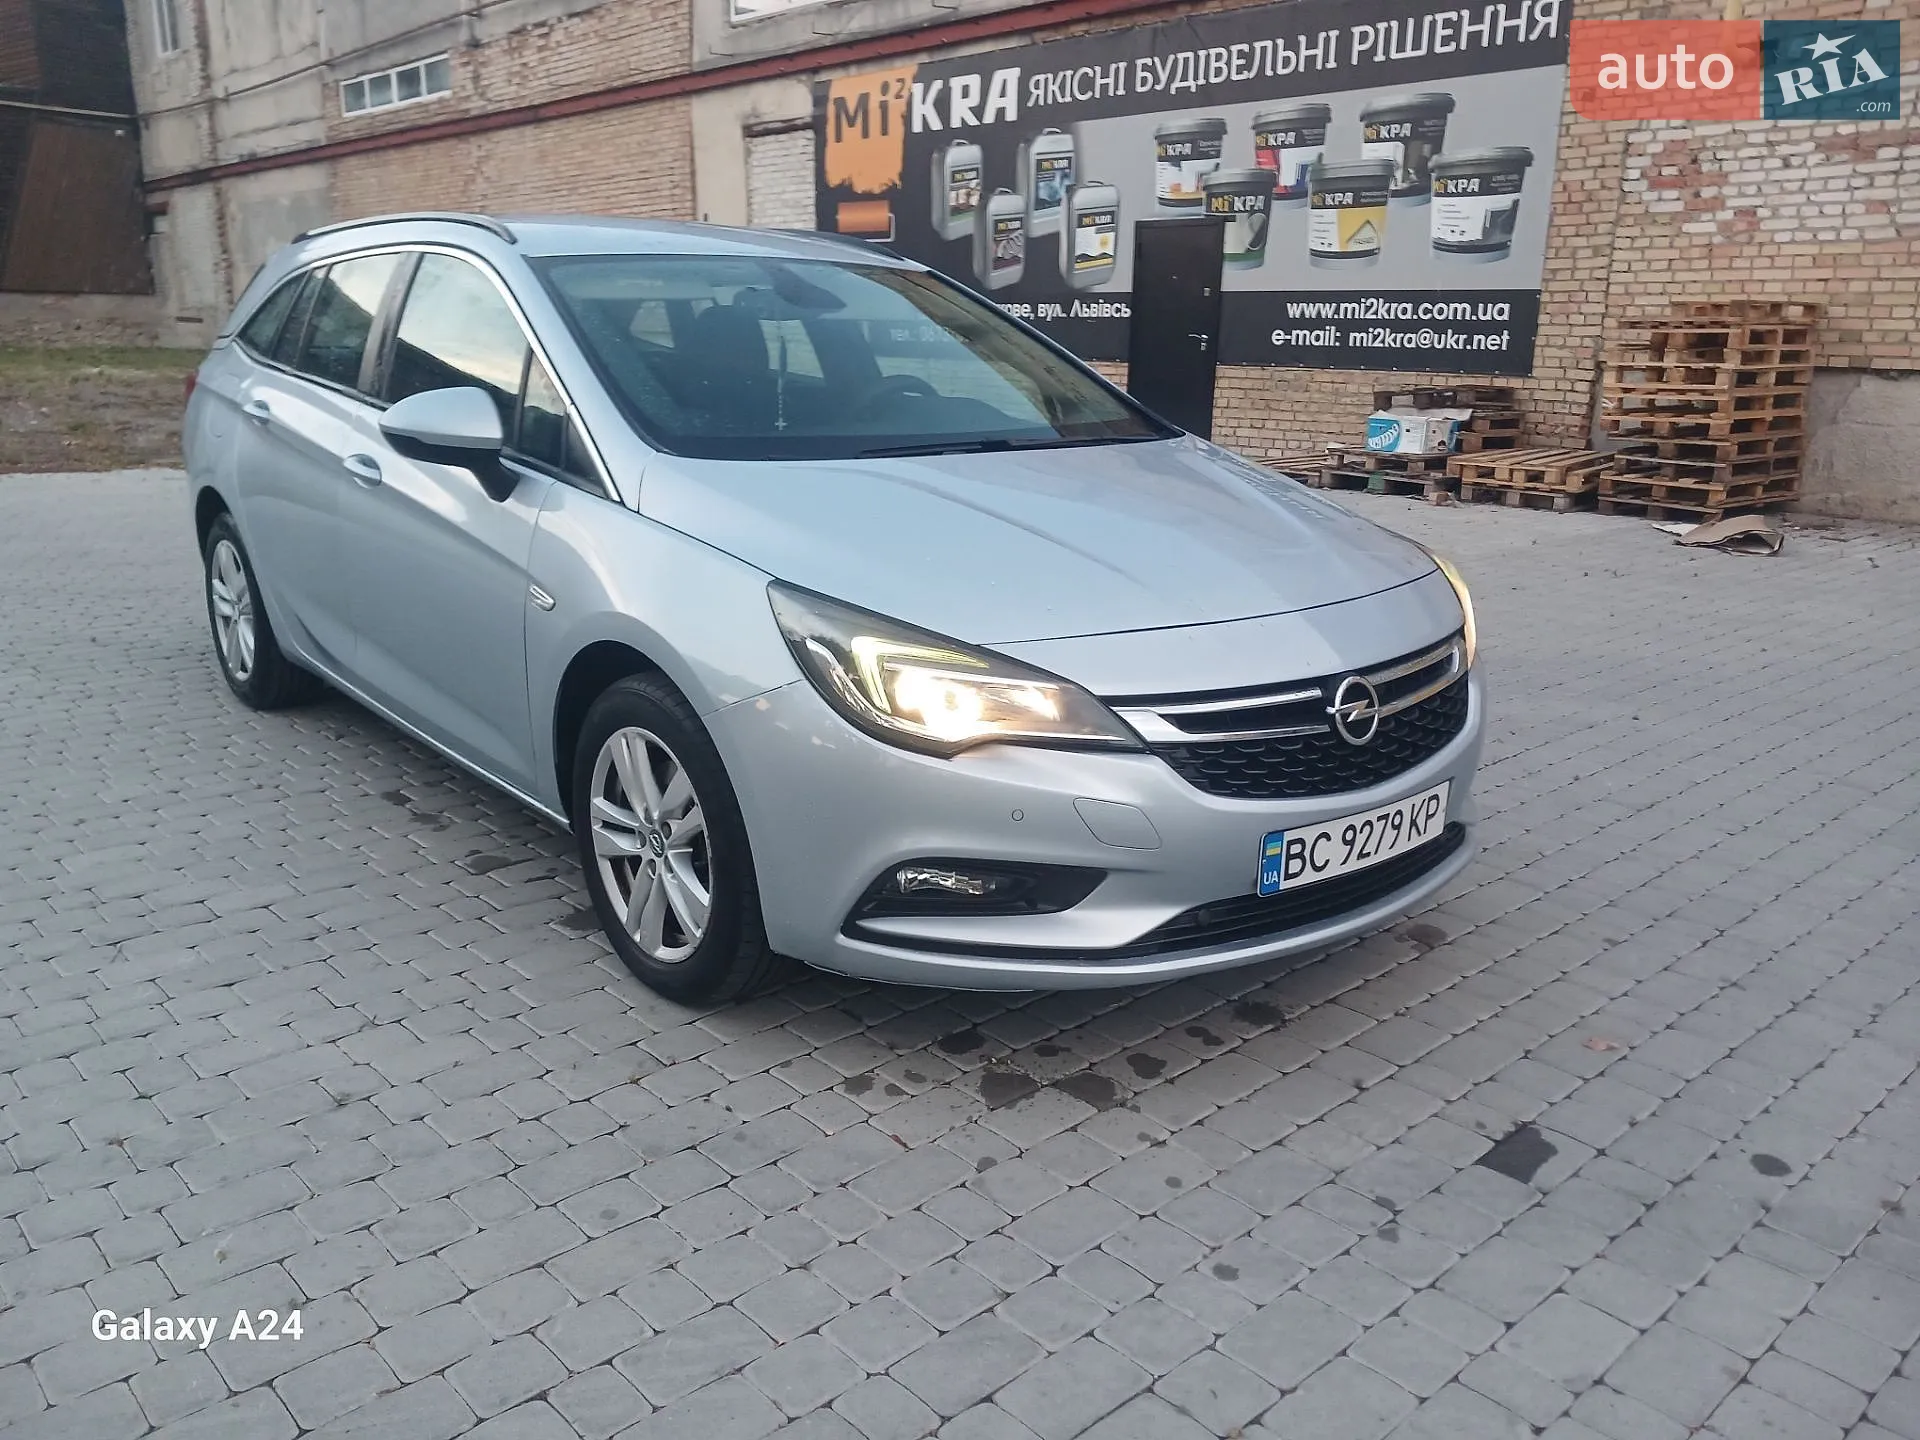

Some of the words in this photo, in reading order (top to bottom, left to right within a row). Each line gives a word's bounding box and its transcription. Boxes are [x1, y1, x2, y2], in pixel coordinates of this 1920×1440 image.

[1027, 61, 1128, 107] ЯКІСНІ
[1134, 29, 1340, 95] БУДІВЕЛЬНІ
[1351, 0, 1561, 66] РІШЕННЯ
[997, 303, 1034, 321] ове,
[1037, 303, 1066, 321] вул.
[1286, 298, 1510, 321] www.mi2kra.com.ua
[1271, 326, 1340, 346] e-mail:
[1349, 328, 1510, 350] mi2kra@ukr.net
[1284, 831, 1332, 881] BC
[1340, 809, 1404, 866] 9279
[1407, 793, 1440, 842] KP
[1264, 870, 1280, 885] UA
